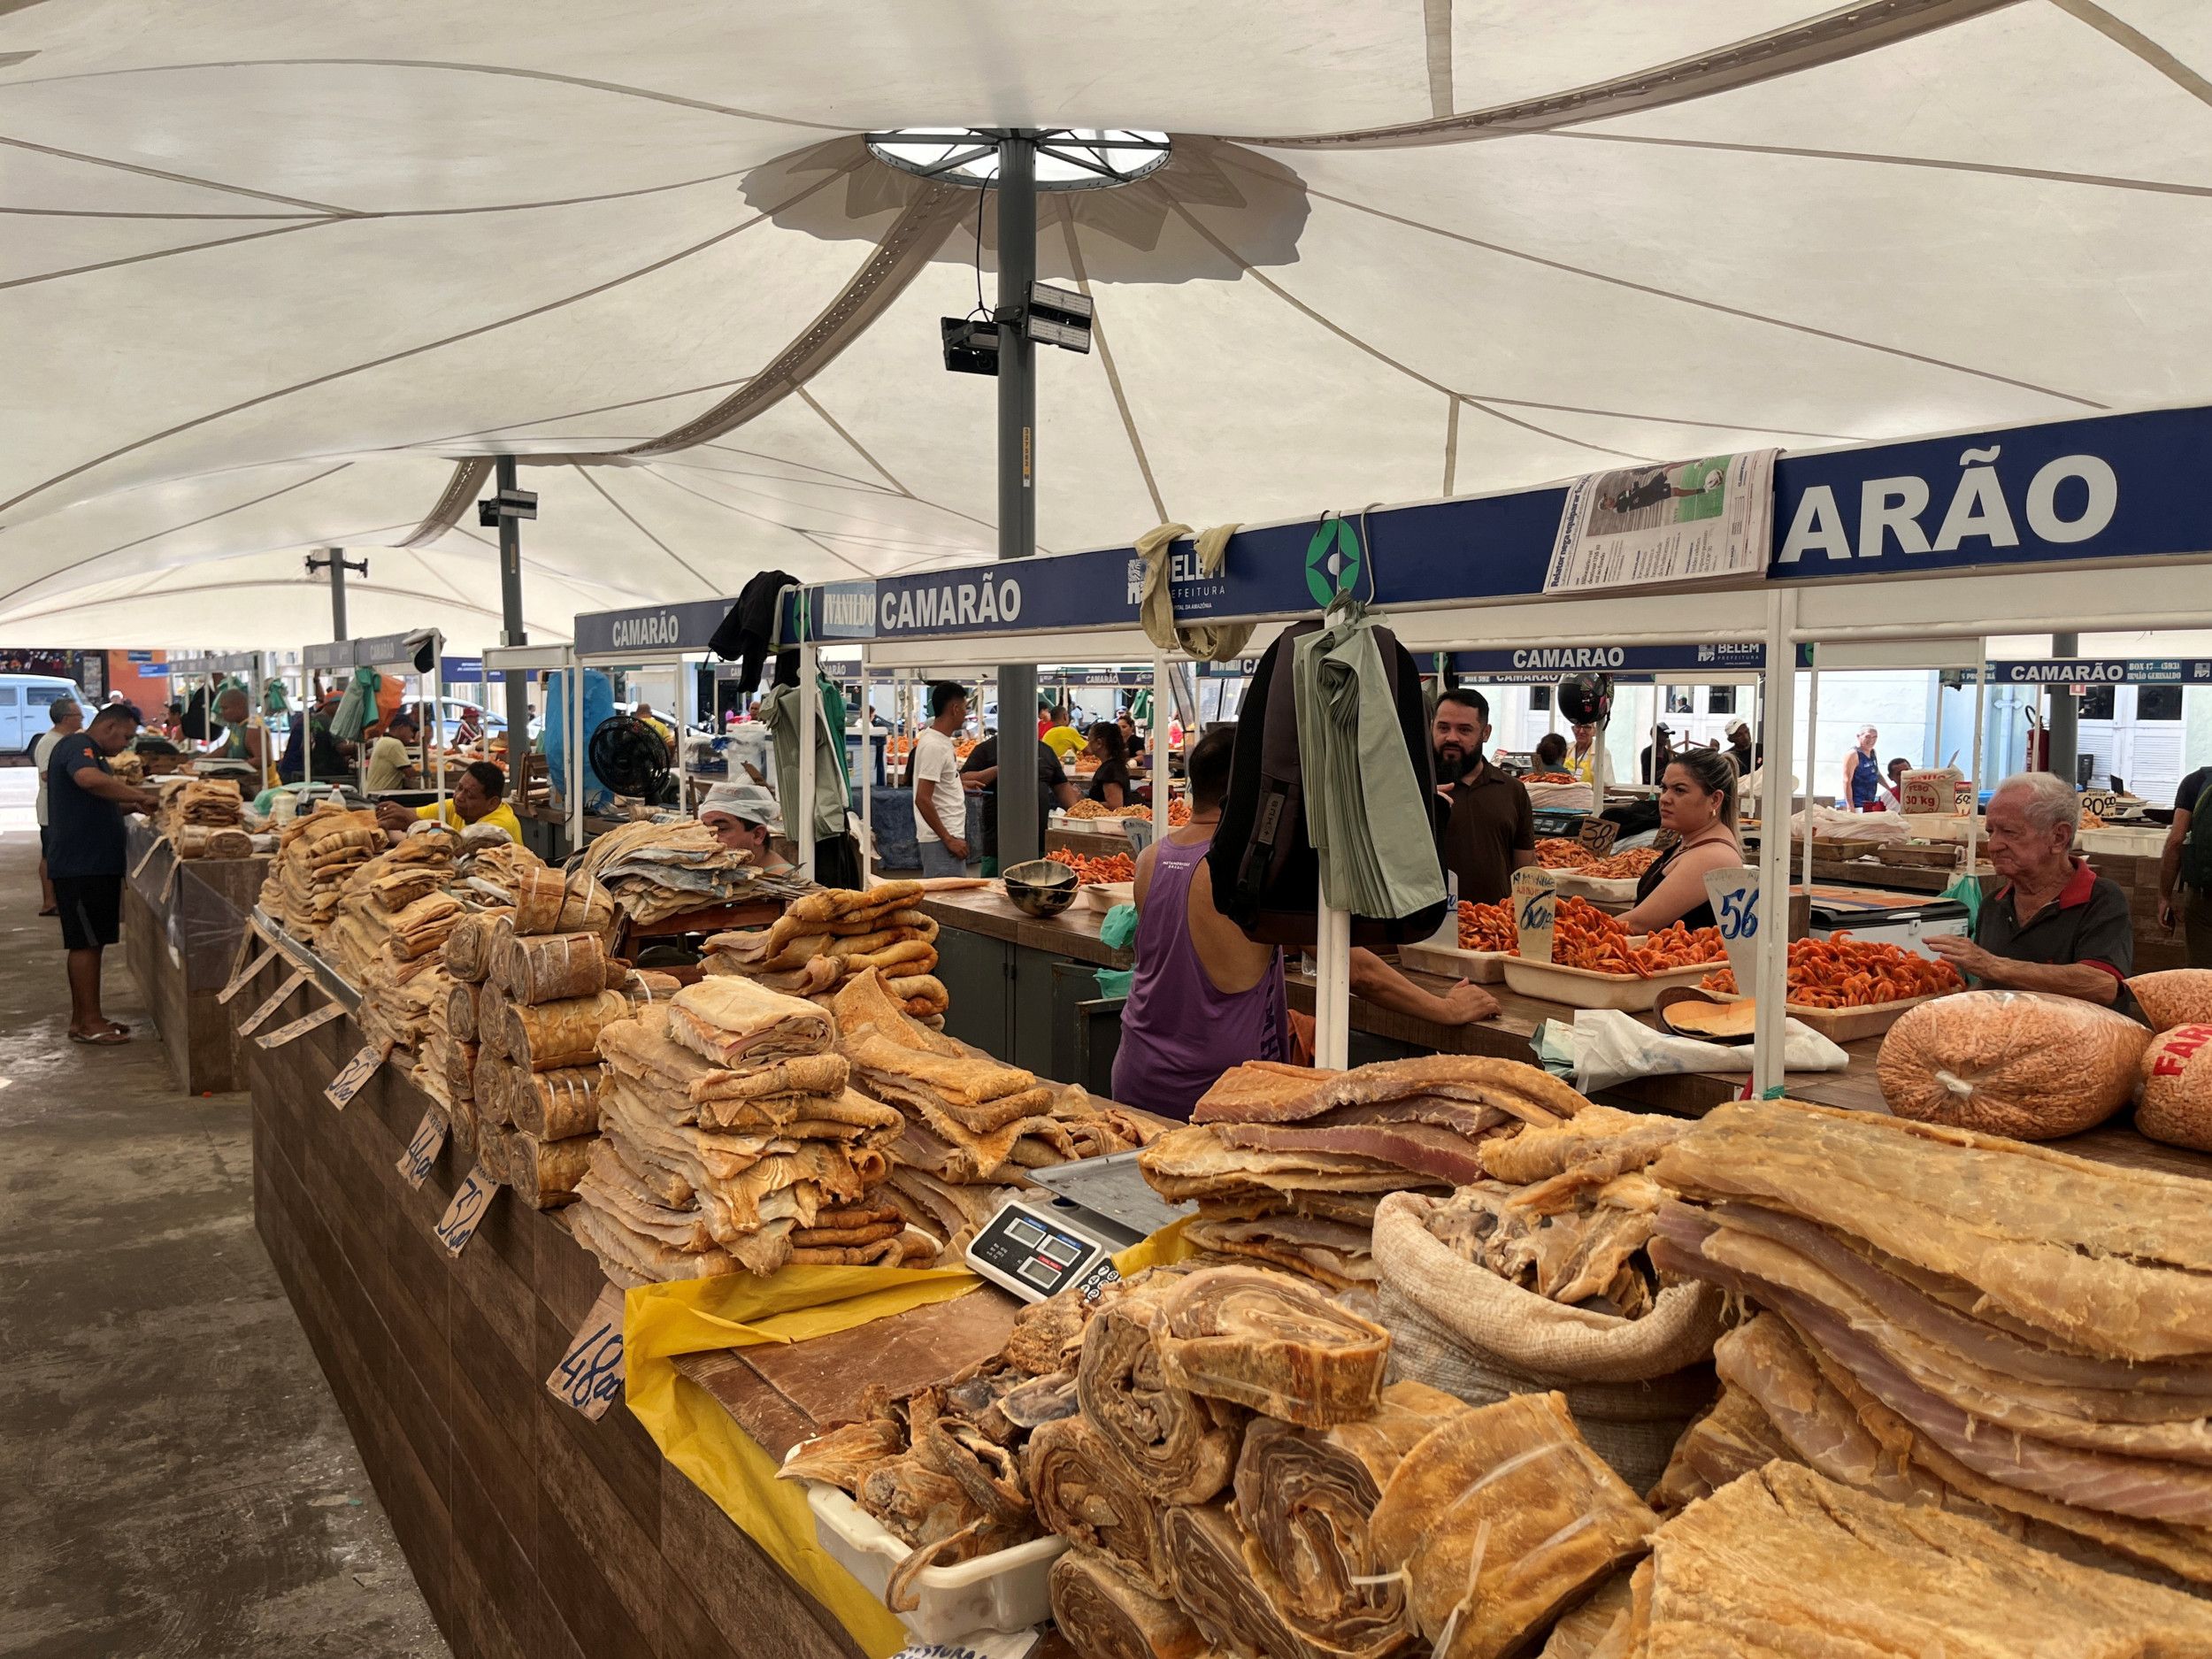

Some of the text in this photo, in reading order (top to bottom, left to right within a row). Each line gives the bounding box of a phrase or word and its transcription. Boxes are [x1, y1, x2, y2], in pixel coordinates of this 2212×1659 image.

[1565, 495, 1579, 533] equiparar
[1779, 445, 2117, 564] ARÃO
[1561, 534, 1571, 555] nega
[1171, 551, 1225, 582] ELEM
[1551, 557, 1564, 587] Relator
[824, 572, 1021, 630] IVANILDO CAMARÃO
[1171, 586, 1225, 598] EFEITURA
[612, 611, 679, 648] CAMARÃO
[1086, 674, 1118, 684] CAMARÃO
[2011, 663, 2124, 680] CAMARÃO
[1906, 795, 1935, 806] 30 kg
[2152, 1023, 2212, 1076] FAR
